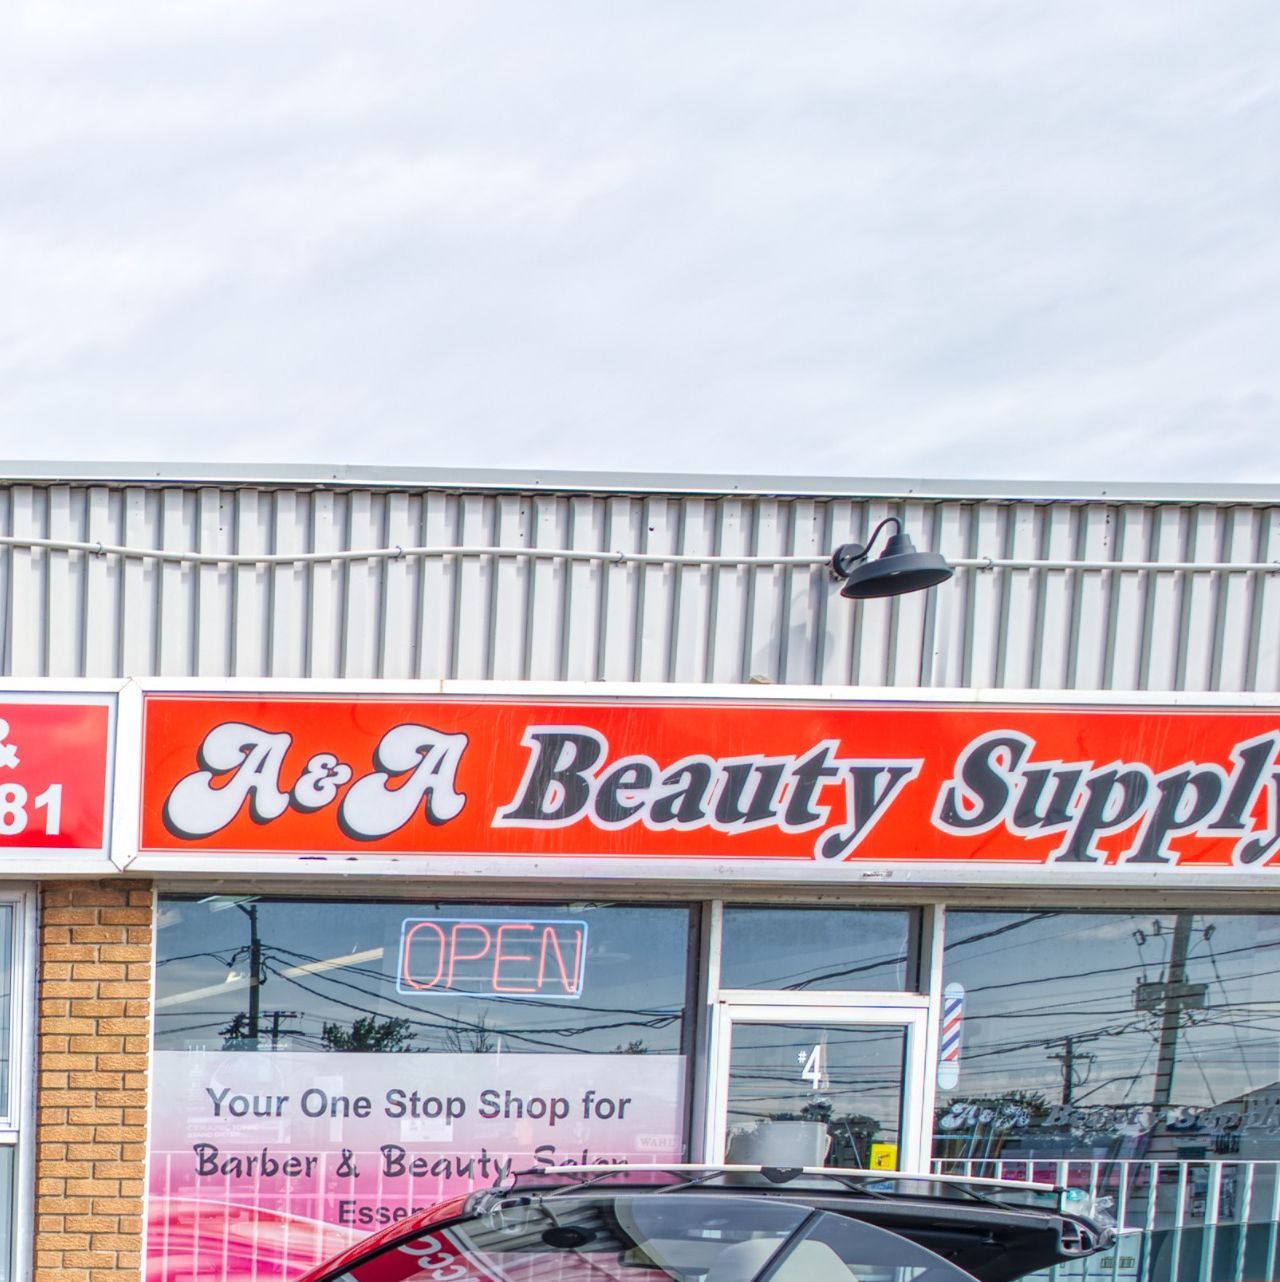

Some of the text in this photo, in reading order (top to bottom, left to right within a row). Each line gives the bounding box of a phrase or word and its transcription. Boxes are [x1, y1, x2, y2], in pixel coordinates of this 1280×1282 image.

[491, 725, 925, 861] Beauty
[403, 922, 582, 995] OPEN
[205, 1088, 631, 1127] Your One Stop Shop for
[193, 1143, 318, 1178] Barber
[335, 1148, 360, 1178] &
[380, 1144, 512, 1189] Beauty
